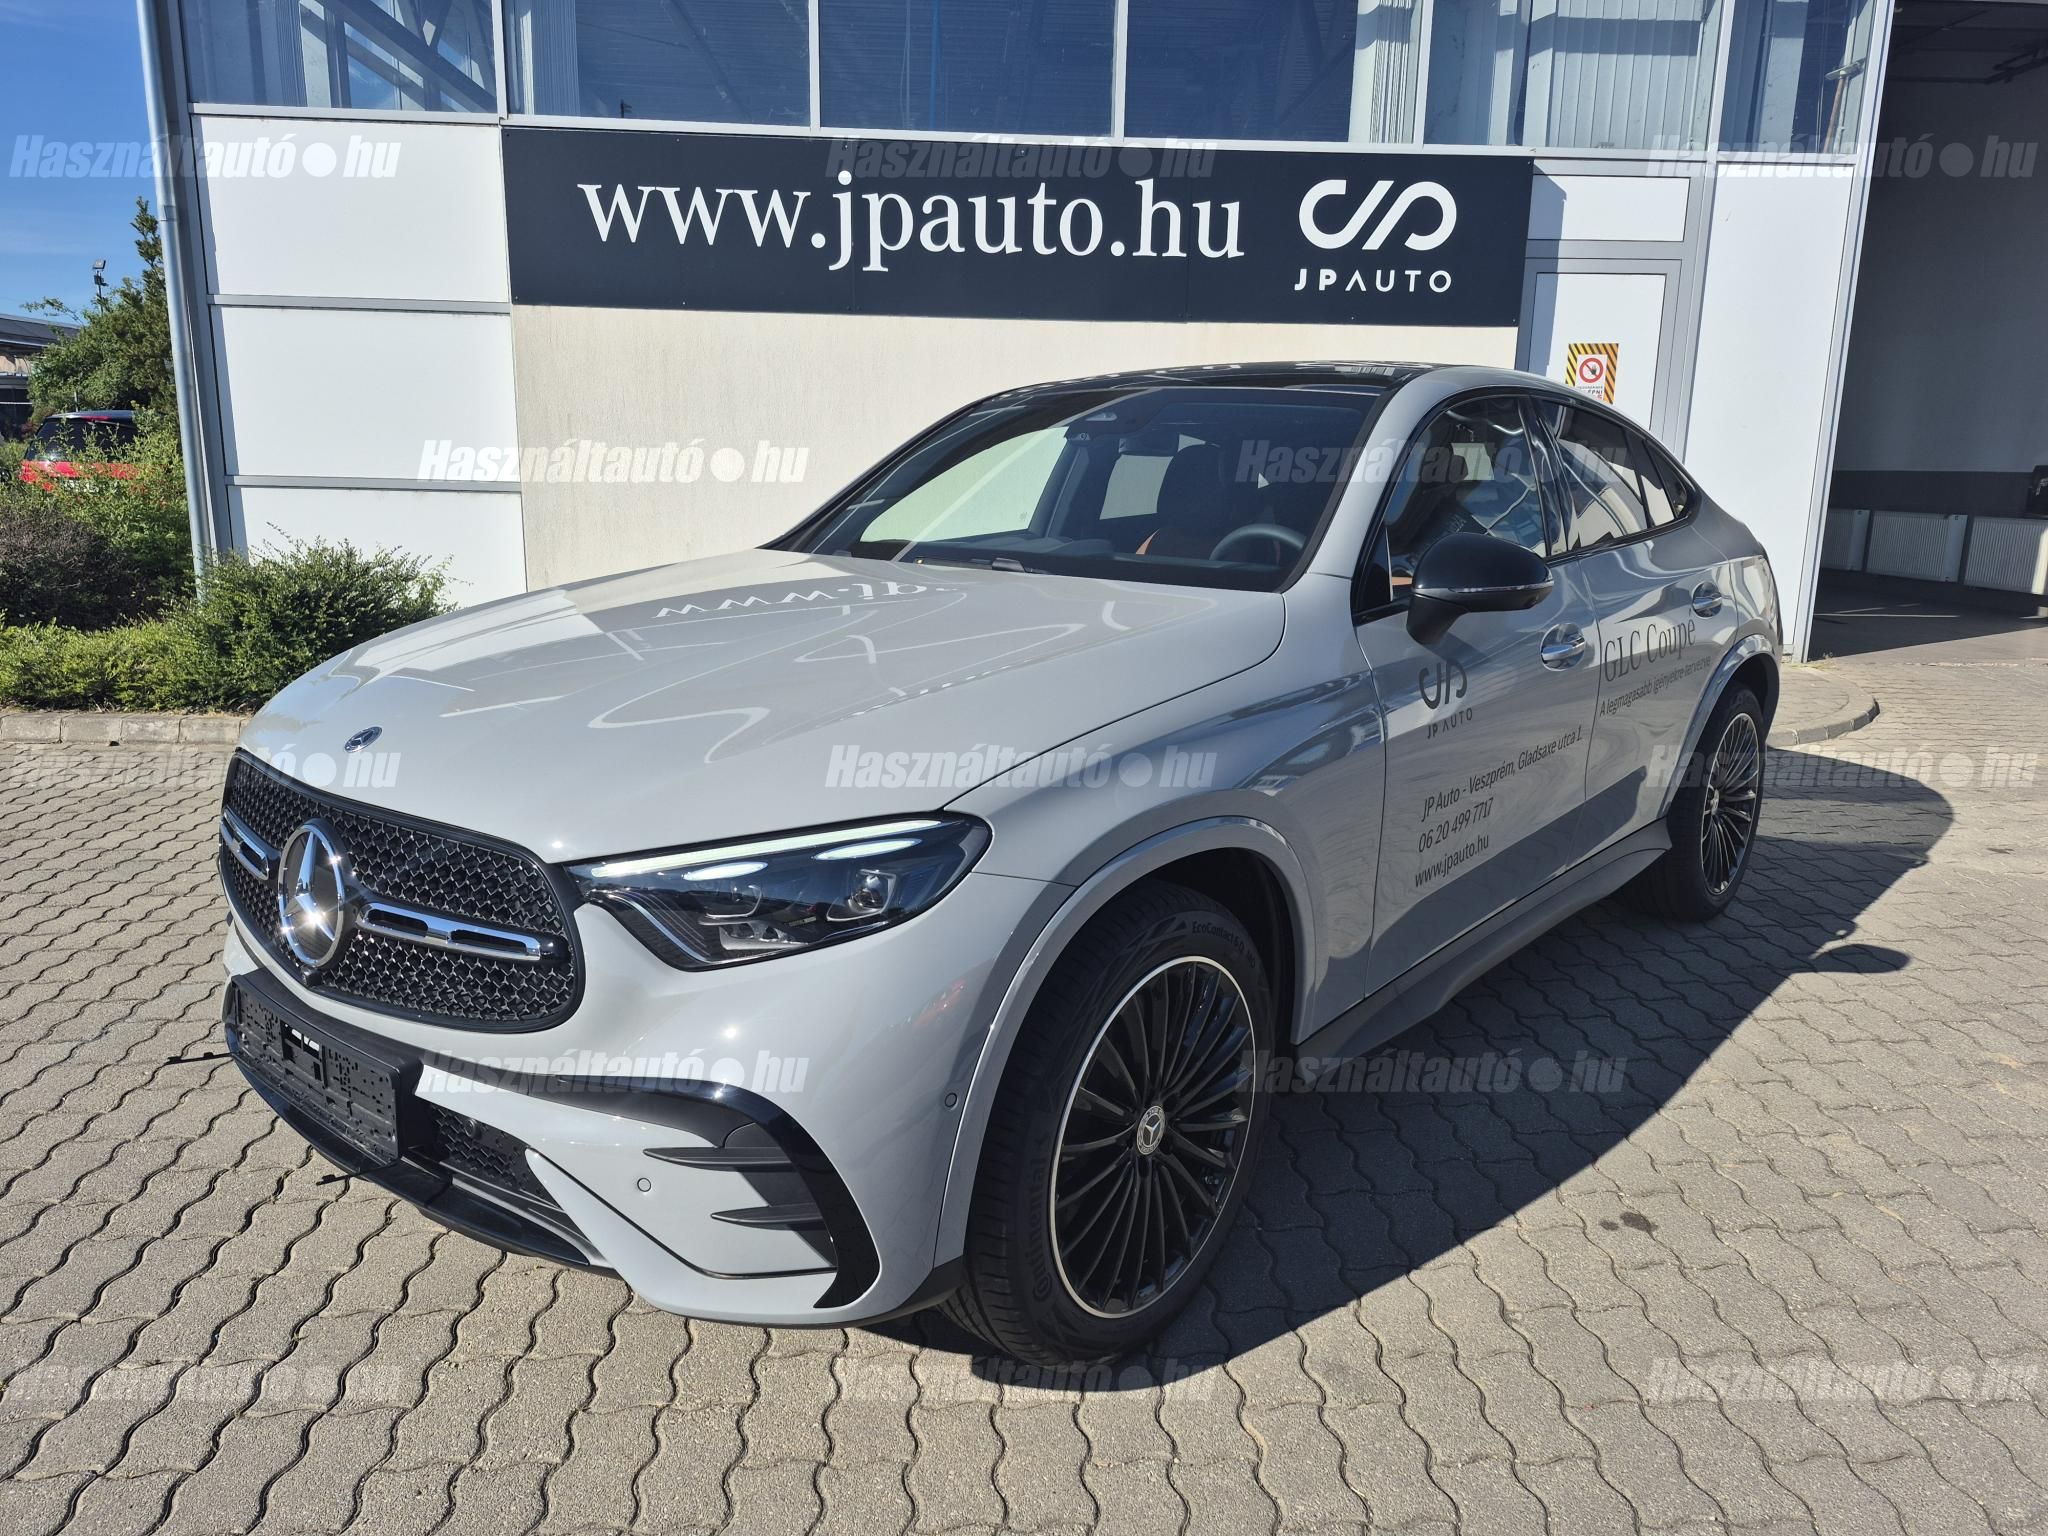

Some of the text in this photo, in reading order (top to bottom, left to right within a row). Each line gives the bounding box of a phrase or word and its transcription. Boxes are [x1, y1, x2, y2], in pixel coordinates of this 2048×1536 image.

[577, 170, 1245, 271] www.jpauto.hu
[1604, 608, 1696, 682] GLC Coupé
[1421, 796, 1435, 822] JP
[1435, 788, 1460, 812] Auto
[1468, 760, 1515, 794] Veszprém,
[1518, 745, 1556, 770] Gladsaxe
[1558, 731, 1576, 750] utca
[1415, 835, 1489, 888] www.jpauto.hu
[1418, 797, 1494, 852] 06 20 499 7717
